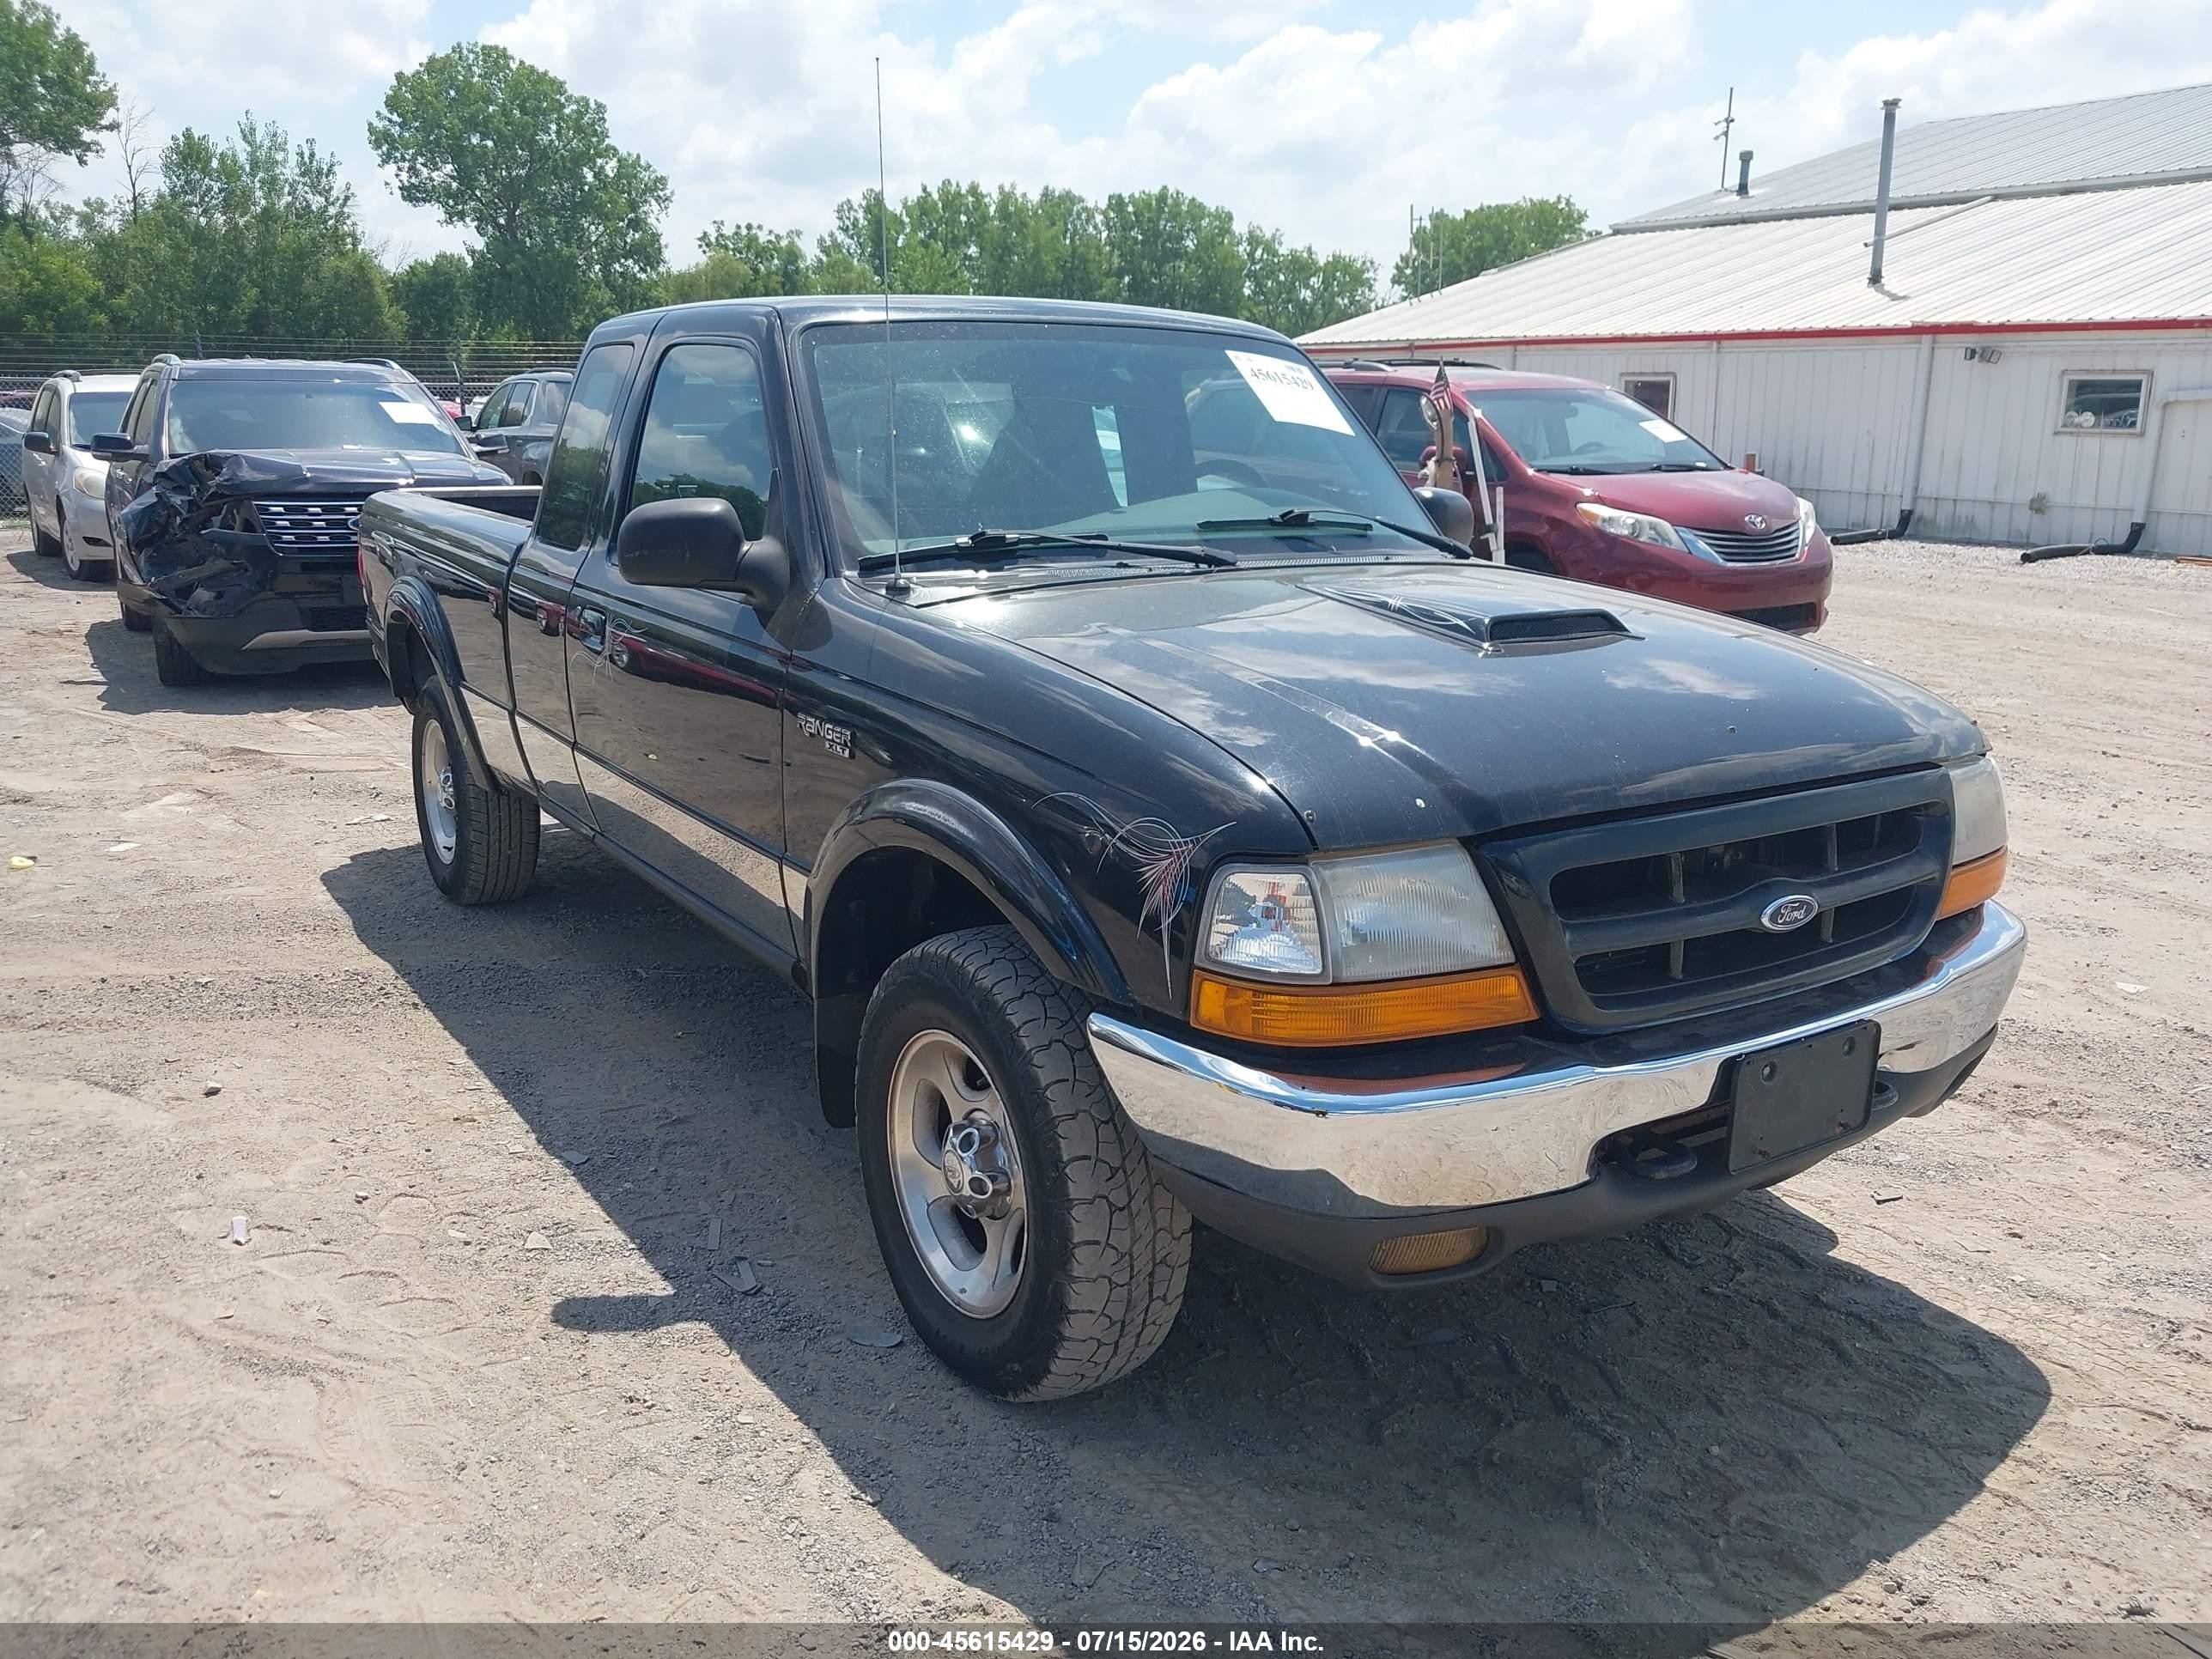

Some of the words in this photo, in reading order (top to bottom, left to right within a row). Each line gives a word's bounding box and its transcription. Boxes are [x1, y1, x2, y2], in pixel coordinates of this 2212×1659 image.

[1250, 367, 1315, 391] 45615429
[826, 742, 849, 757] XLT
[1778, 902, 1808, 924] Ford
